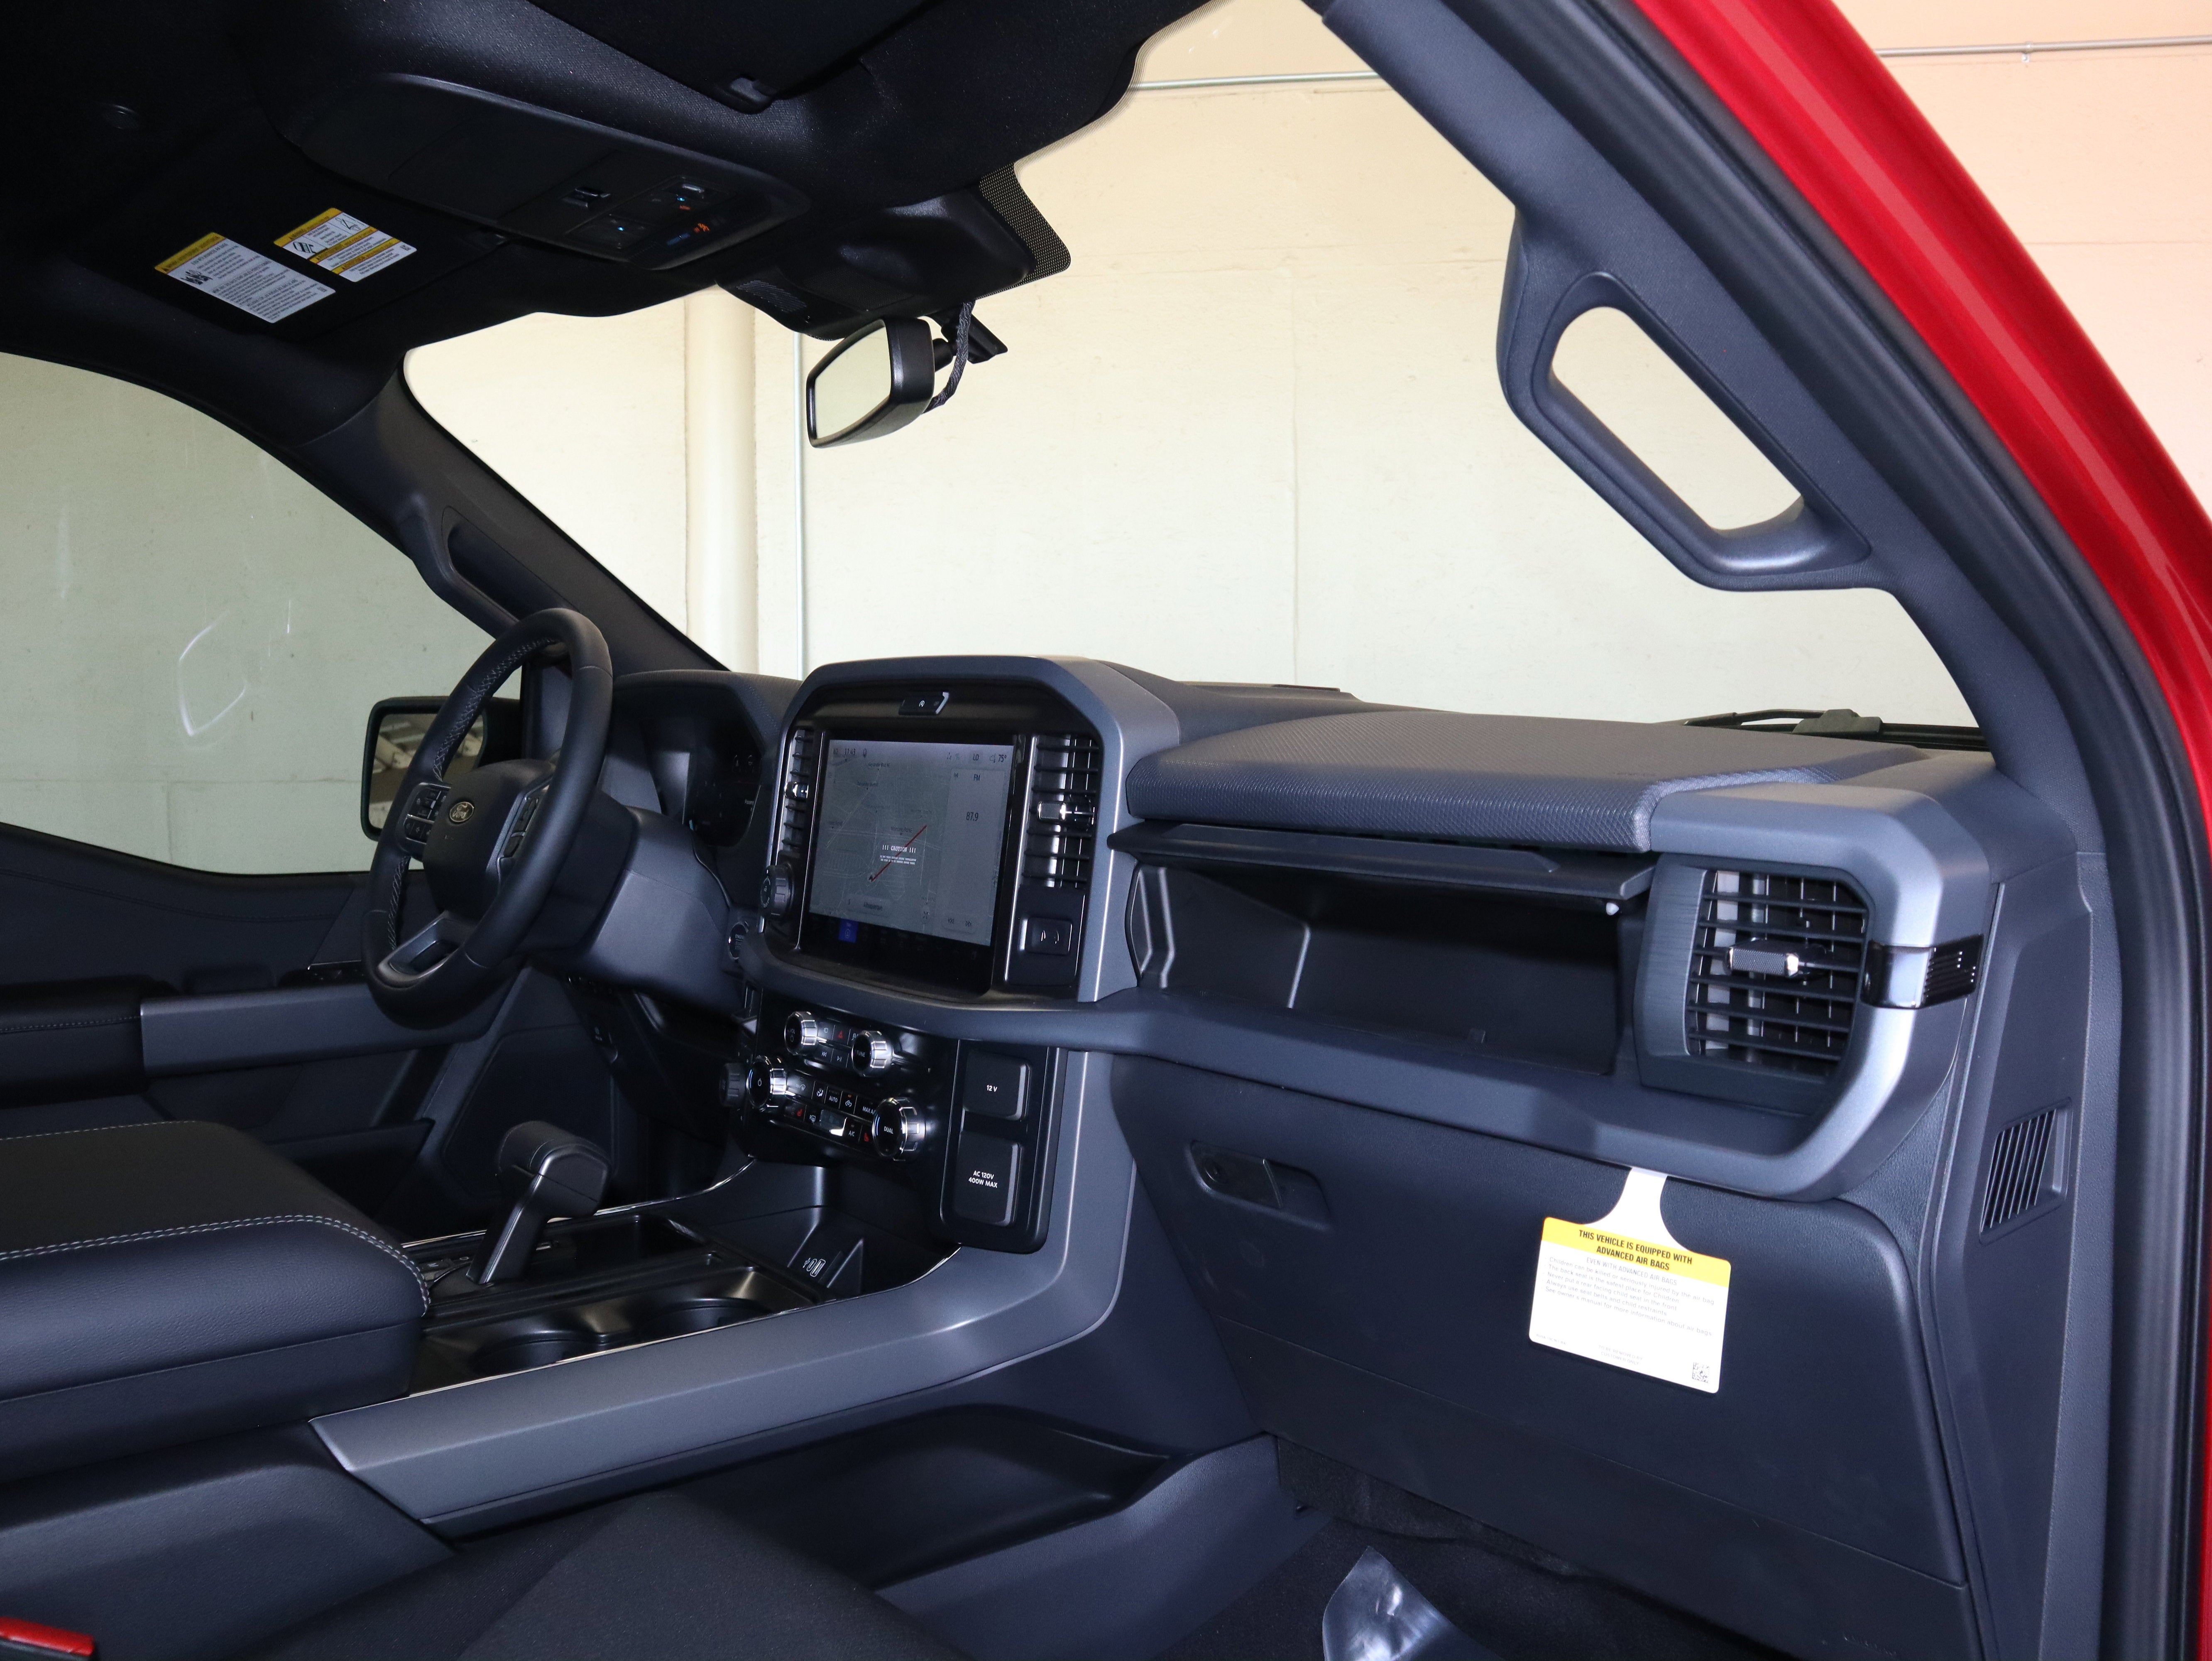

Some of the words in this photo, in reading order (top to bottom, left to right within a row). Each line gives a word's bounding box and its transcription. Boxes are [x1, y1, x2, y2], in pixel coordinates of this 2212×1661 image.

[452, 803, 470, 819] Ford
[966, 812, 979, 821] 87.9
[883, 1126, 894, 1134] DUAL
[968, 1177, 984, 1185] 400W
[985, 1180, 998, 1188] MAX
[1579, 1230, 1594, 1240] THIS
[1596, 1234, 1625, 1248] VEHICLE
[1626, 1242, 1633, 1250] IS
[1635, 1244, 1671, 1259] EQUIPPED
[1673, 1253, 1692, 1264] WITH
[1596, 1246, 1634, 1262] ADVANCED
[1636, 1256, 1648, 1265] AIR
[1650, 1259, 1669, 1271] BAGS
[1549, 1257, 1573, 1267] Children
[1595, 1269, 1610, 1278] killed
[1620, 1276, 1647, 1288] seriously
[1649, 1283, 1670, 1293] injured
[1703, 1297, 1714, 1306] bag
[1586, 1257, 1600, 1266] EVEN
[1603, 1261, 1617, 1270] WITH
[1618, 1266, 1648, 1278] ADVANCED
[1661, 1276, 1677, 1286] BAGS
[1546, 1279, 1566, 1289] Always
[1593, 1292, 1608, 1300] belts
[1622, 1300, 1636, 1308] child
[1638, 1304, 1667, 1316] restraints
[1548, 1271, 1564, 1280] Never
[1594, 1284, 1611, 1295] facing
[1630, 1293, 1642, 1301] seat
[1662, 1302, 1677, 1311] front
[1606, 1279, 1624, 1289] safest
[1625, 1284, 1641, 1294] place
[1654, 1292, 1679, 1303] Children
[1581, 1298, 1602, 1306] manual
[1630, 1310, 1665, 1323] information
[1667, 1320, 1685, 1329] about
[1696, 1327, 1712, 1336] bags
[1601, 1352, 1626, 1361] CUSTOMER
[1613, 1349, 1635, 1359] REMOVED
